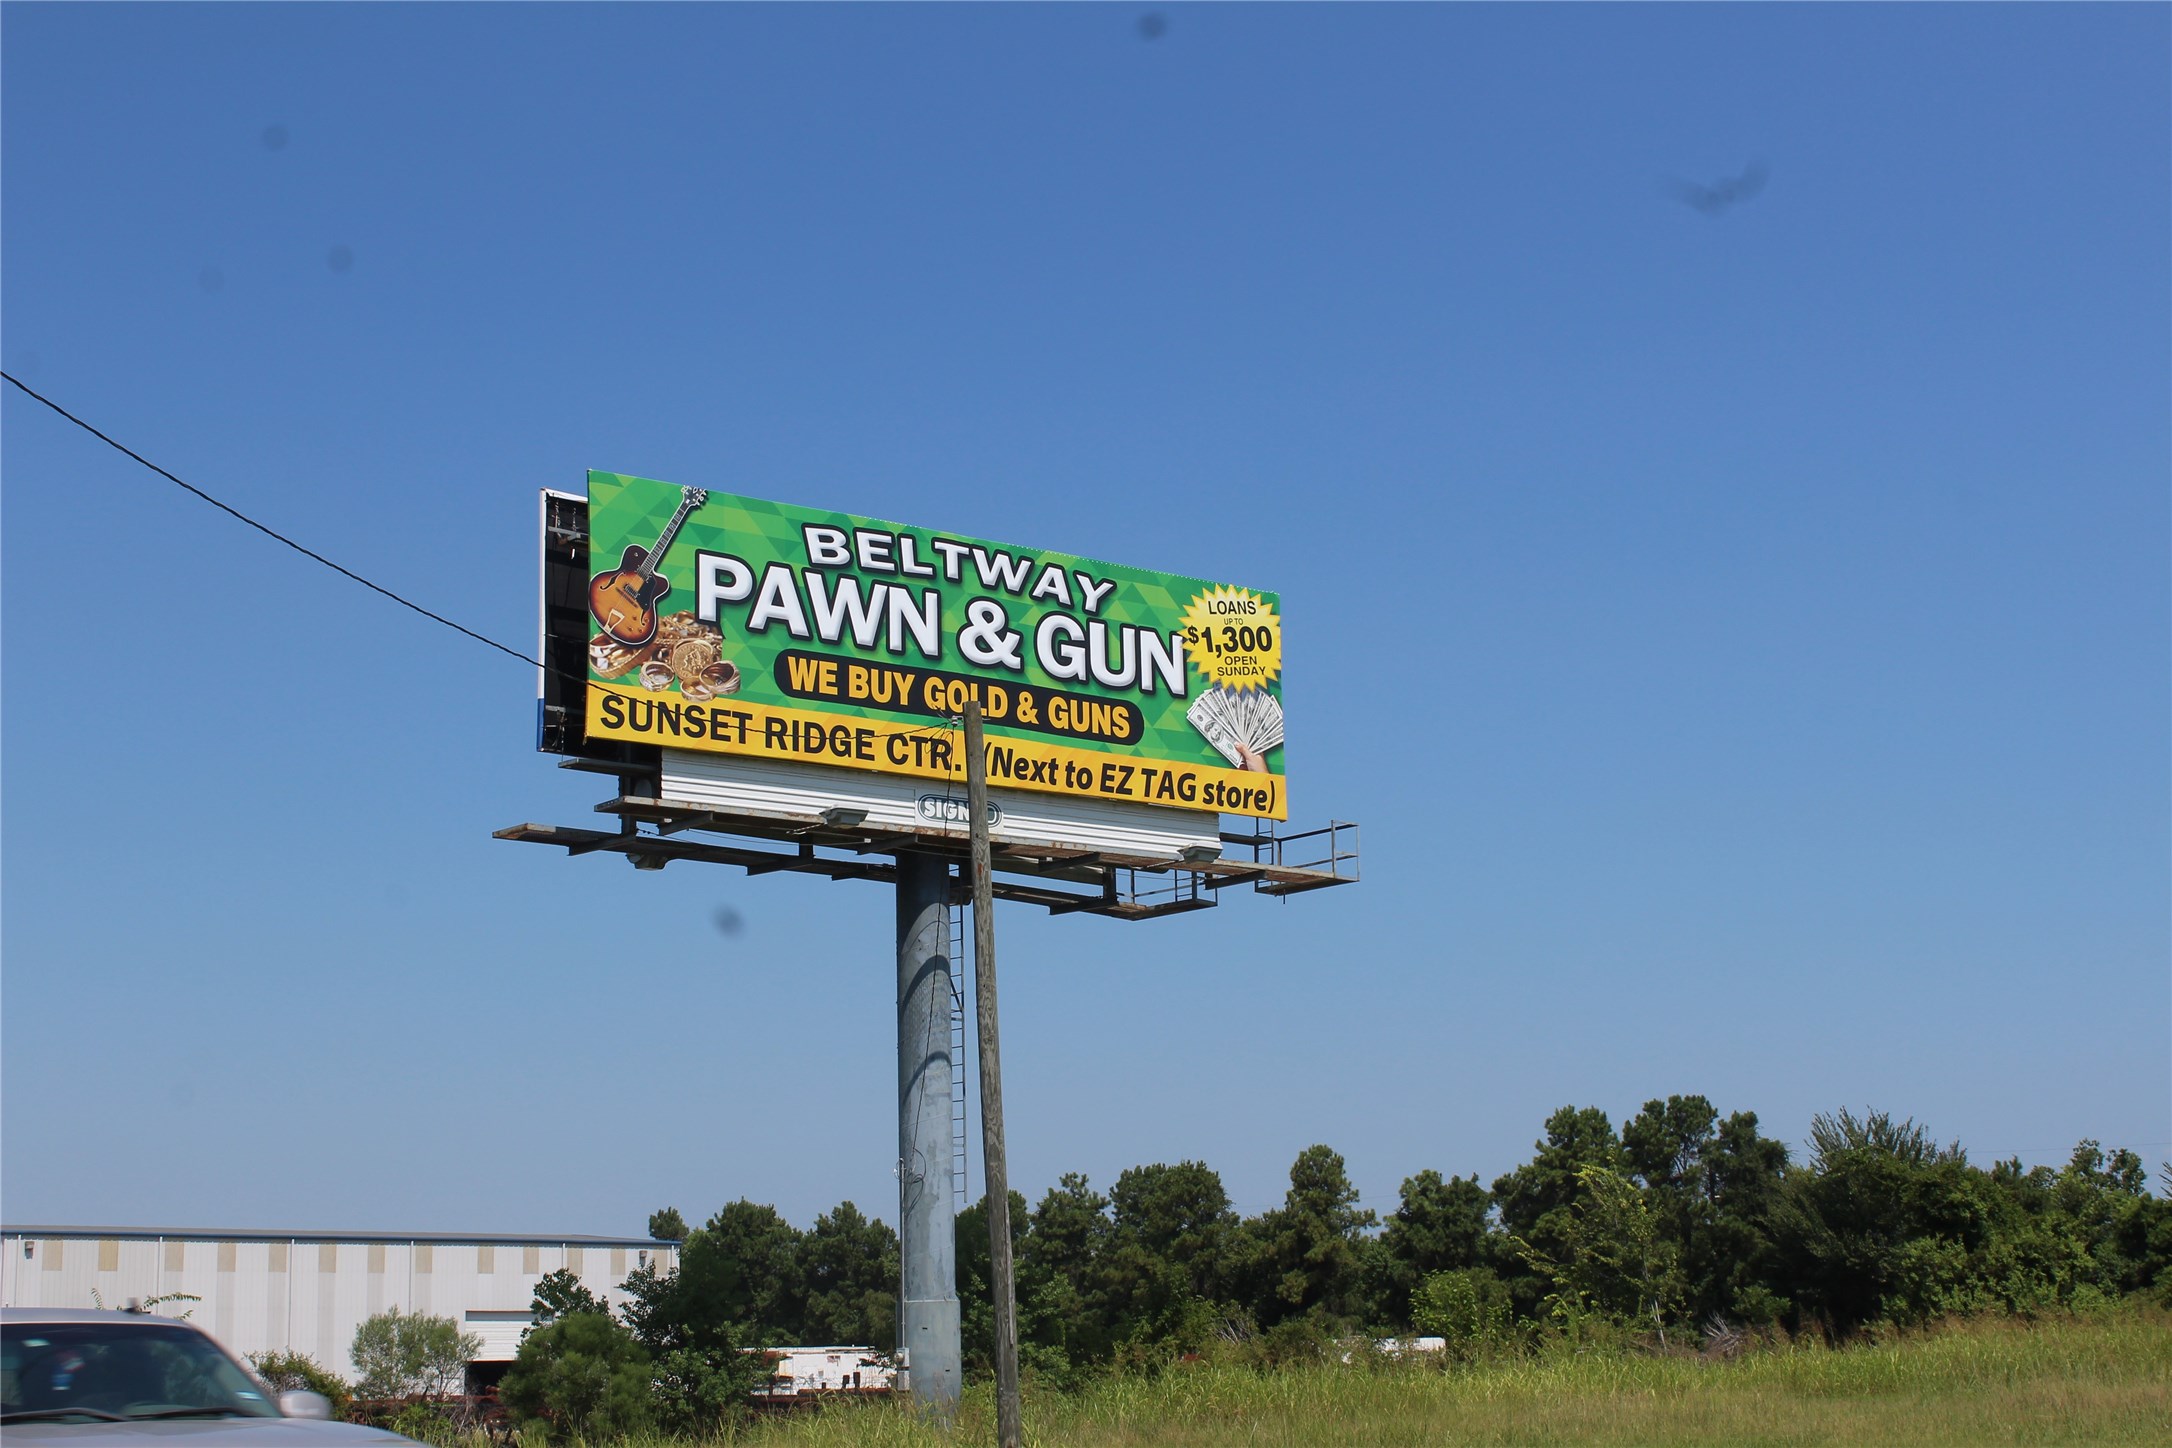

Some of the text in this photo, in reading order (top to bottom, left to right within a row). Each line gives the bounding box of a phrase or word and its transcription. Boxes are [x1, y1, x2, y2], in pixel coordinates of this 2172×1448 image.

[803, 525, 1114, 613] BELTWAY
[698, 552, 1186, 696] PAWN & GUN
[1208, 600, 1256, 615] LOANS
[1234, 618, 1244, 626] TO
[1187, 625, 1272, 658] $1,300
[1217, 666, 1266, 677] SUNDAY
[1224, 656, 1257, 666] OPEN
[787, 655, 1131, 739] WE BUY GOLD & GUNS
[600, 695, 1275, 813] SUNSET RIDGE CTR. (Next to EZ TAG store)
